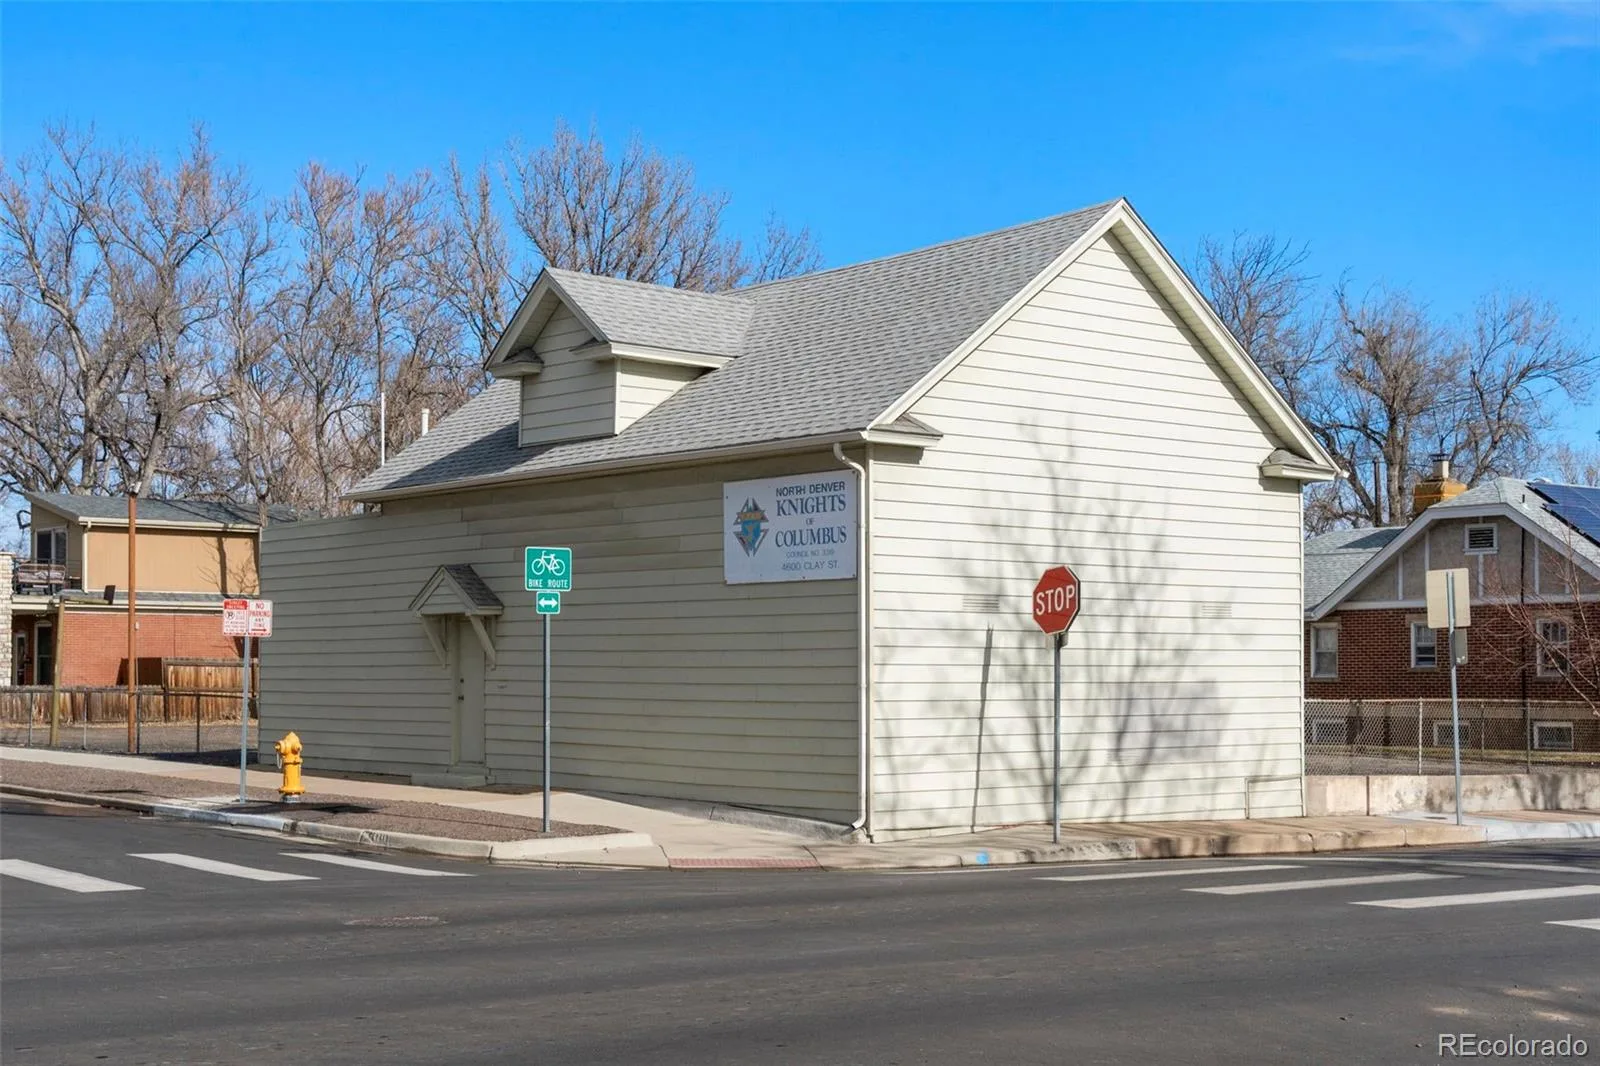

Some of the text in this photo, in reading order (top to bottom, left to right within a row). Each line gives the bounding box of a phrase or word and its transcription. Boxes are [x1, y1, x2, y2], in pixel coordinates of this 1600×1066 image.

[776, 481, 845, 497] NORTH DENVER
[776, 494, 846, 516] KNIGHTS
[806, 517, 815, 526] OF
[775, 525, 847, 548] COLUMBUS
[782, 559, 840, 571] 4600 CLAY ST.
[528, 579, 568, 588] BIKE ROUTE
[1035, 584, 1075, 616] STOP
